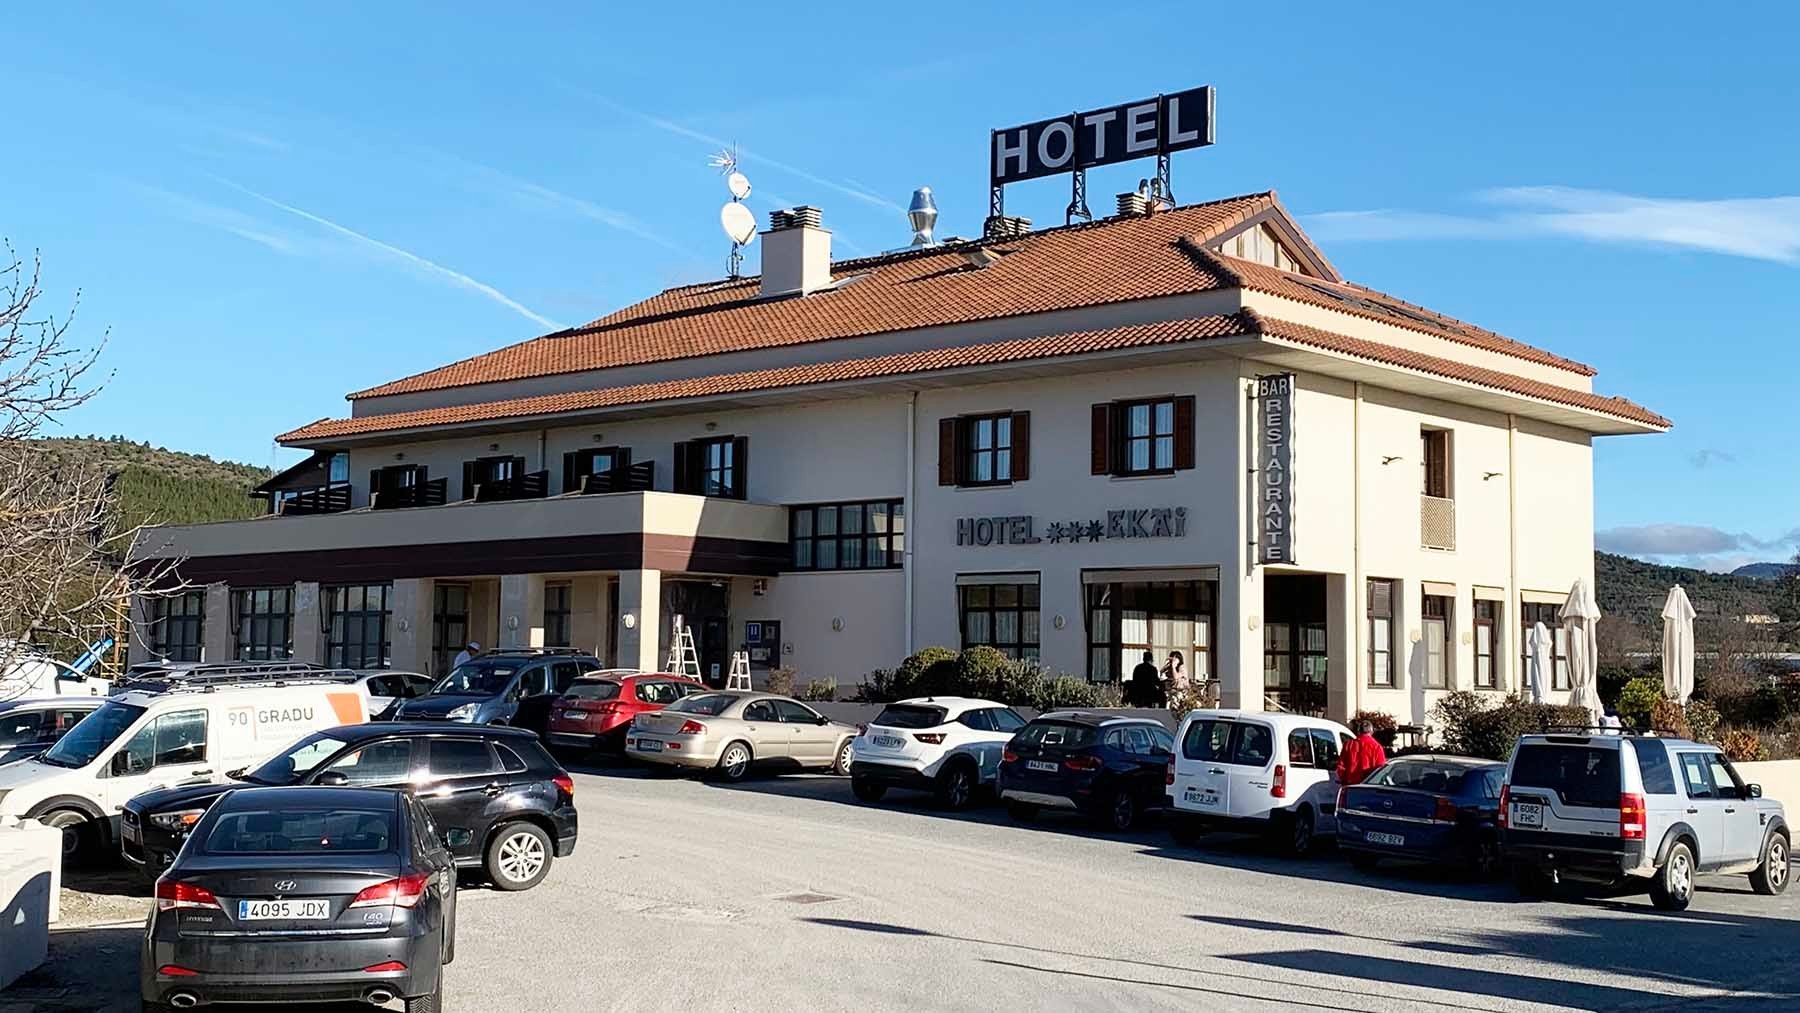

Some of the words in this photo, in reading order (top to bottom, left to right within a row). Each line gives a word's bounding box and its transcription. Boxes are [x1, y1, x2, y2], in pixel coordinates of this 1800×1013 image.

[996, 97, 1198, 177] HOTEL
[1260, 377, 1289, 396] BAR
[1265, 398, 1283, 560] RESTAURANTE
[956, 516, 1042, 546] HOTEL
[228, 711, 248, 726] 90
[258, 707, 314, 723] GRADU
[1520, 804, 1540, 814] 6082
[1520, 814, 1536, 823] FHC
[251, 903, 290, 917] 4095
[296, 902, 325, 917] JDX
